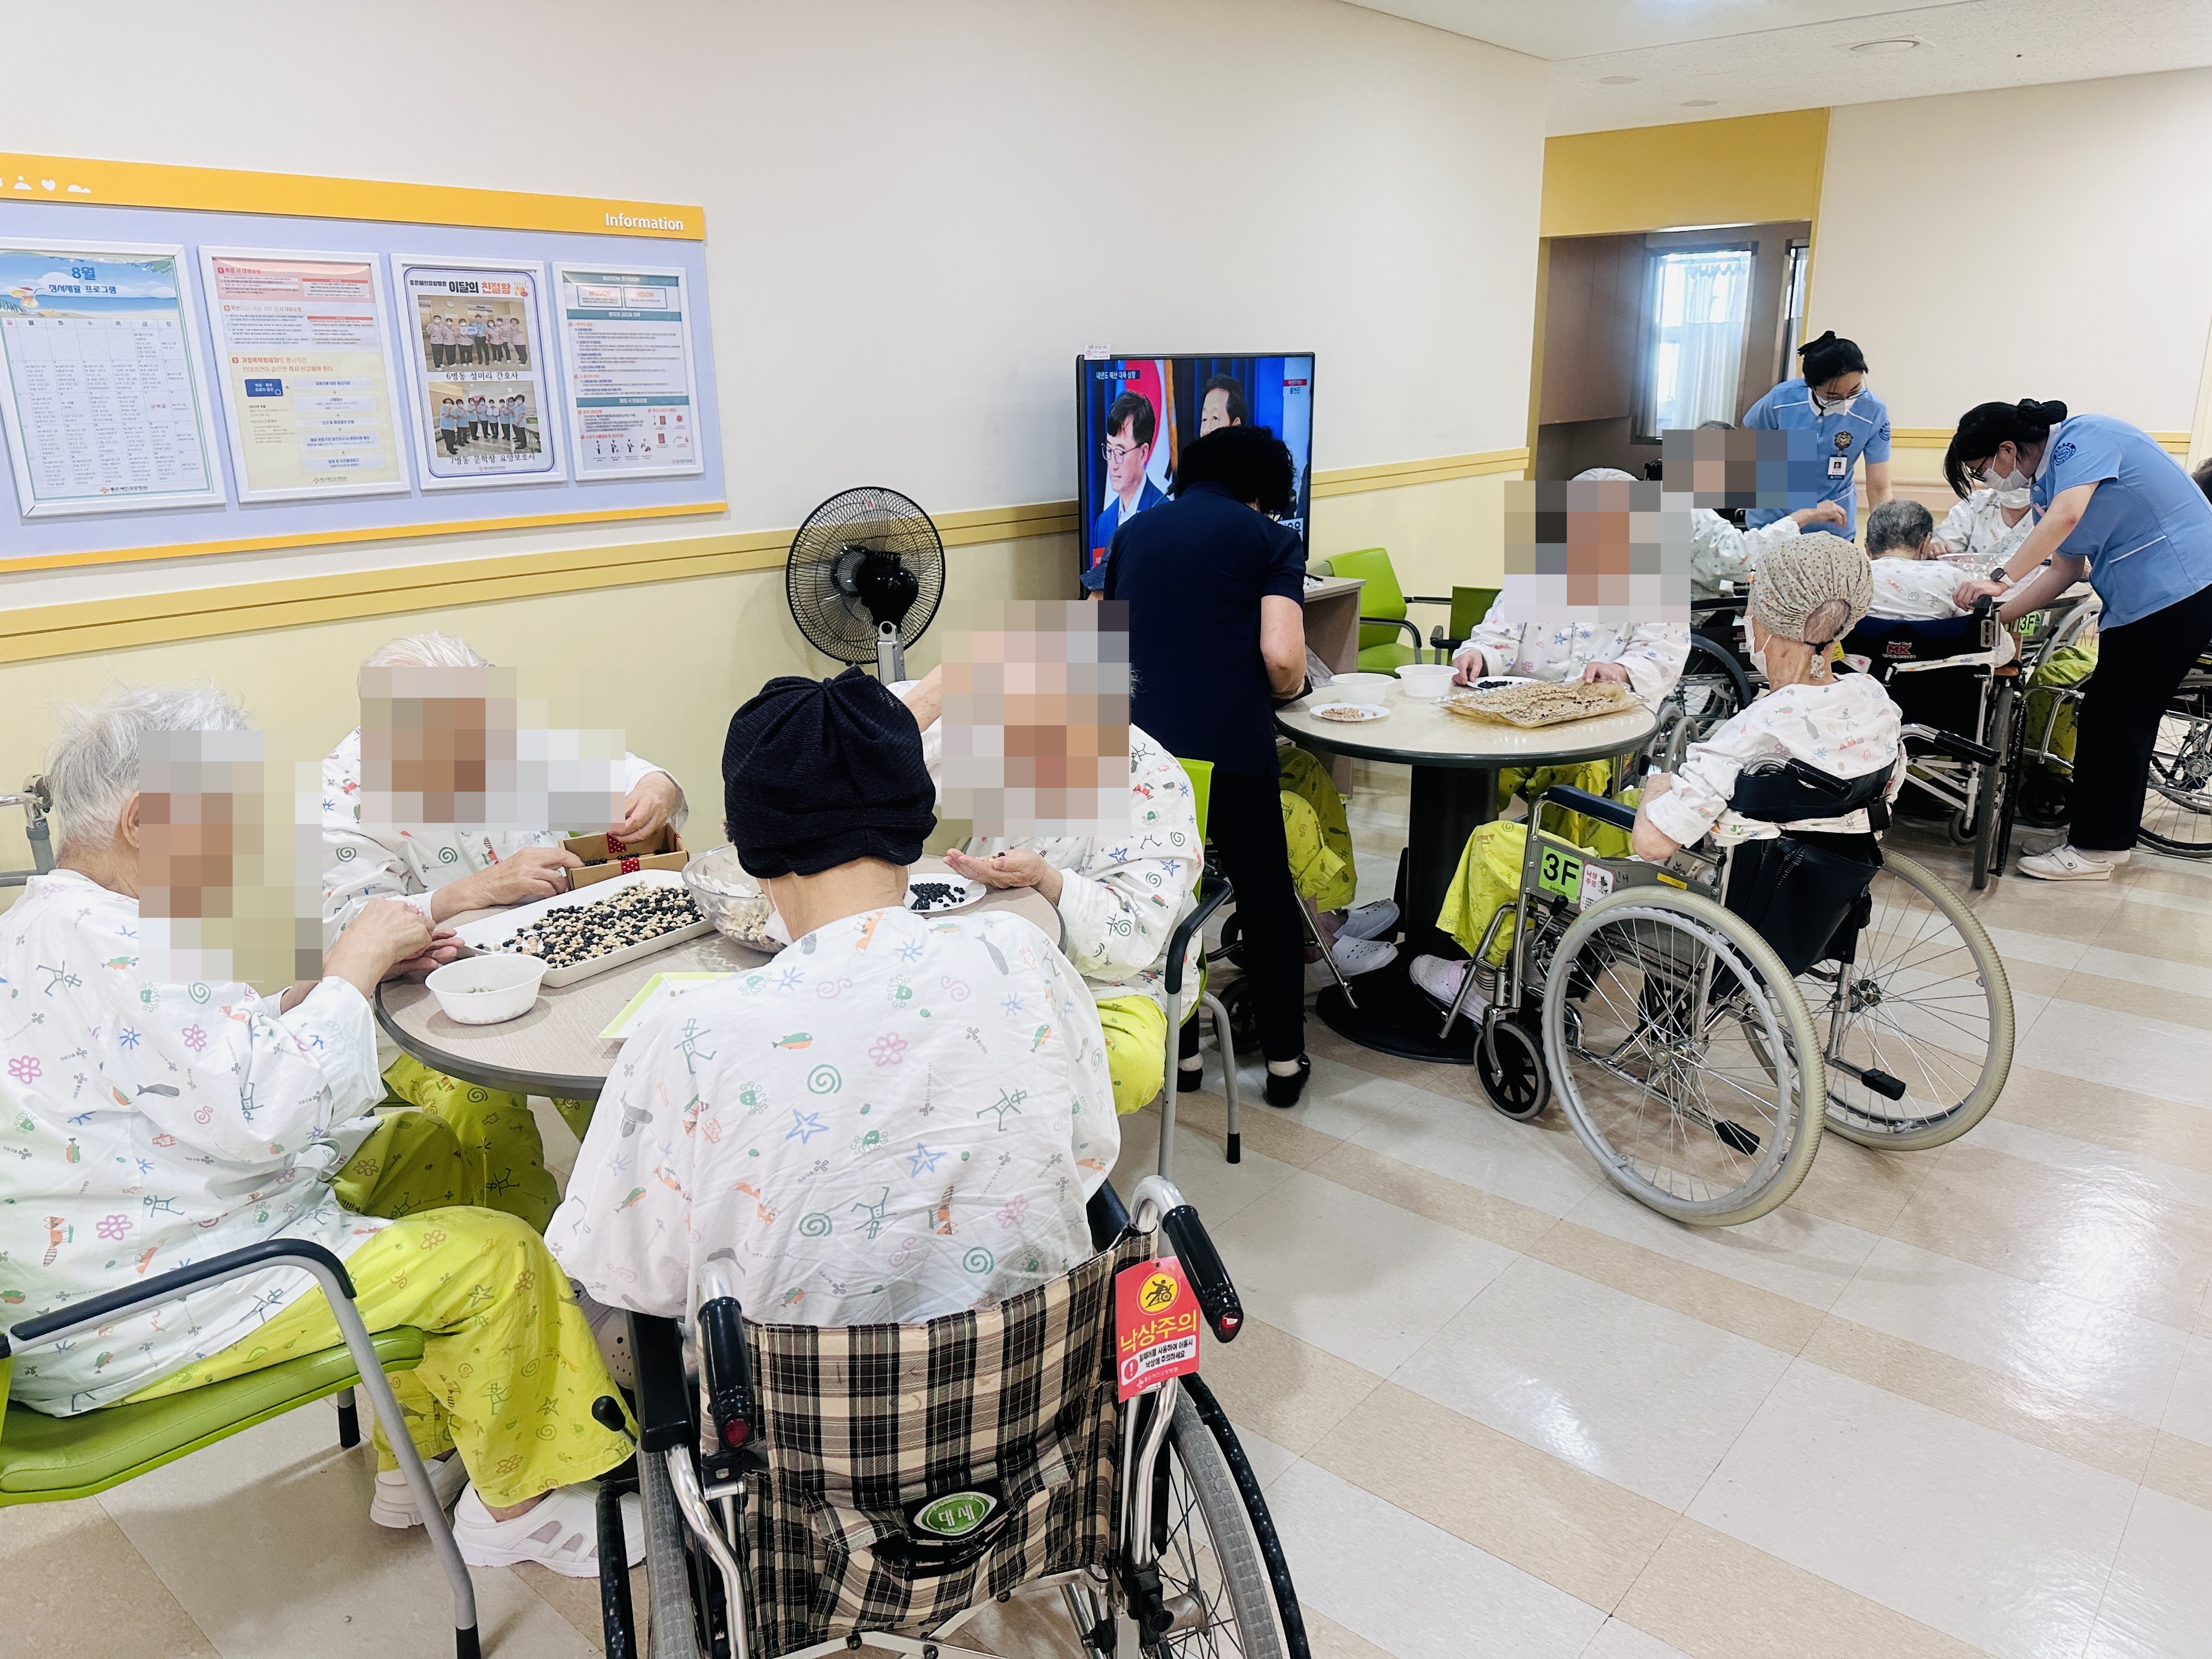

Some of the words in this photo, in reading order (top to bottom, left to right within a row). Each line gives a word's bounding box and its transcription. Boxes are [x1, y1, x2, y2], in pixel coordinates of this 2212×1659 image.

[605, 212, 684, 232] Information
[72, 267, 96, 280] 8월
[85, 285, 117, 294] 프로그램
[449, 281, 479, 294] 이달의
[481, 281, 511, 294] 친절왕
[446, 372, 466, 381] 6병동
[470, 371, 492, 380] 성미리
[496, 371, 518, 380] 간호사
[450, 455, 470, 465] 7병동
[500, 453, 535, 462] 요양보호사
[2020, 615, 2035, 630] 3F
[1887, 645, 1912, 654] MK
[1543, 853, 1579, 886] 3F
[1120, 1309, 1197, 1352] 낙상주의
[1139, 1348, 1157, 1363] 휠체어를
[1158, 1342, 1177, 1355] 사용하여
[1178, 1338, 1193, 1349] 이동시
[1146, 1357, 1160, 1368] 낙상에
[1161, 1350, 1185, 1363] 주의하세요
